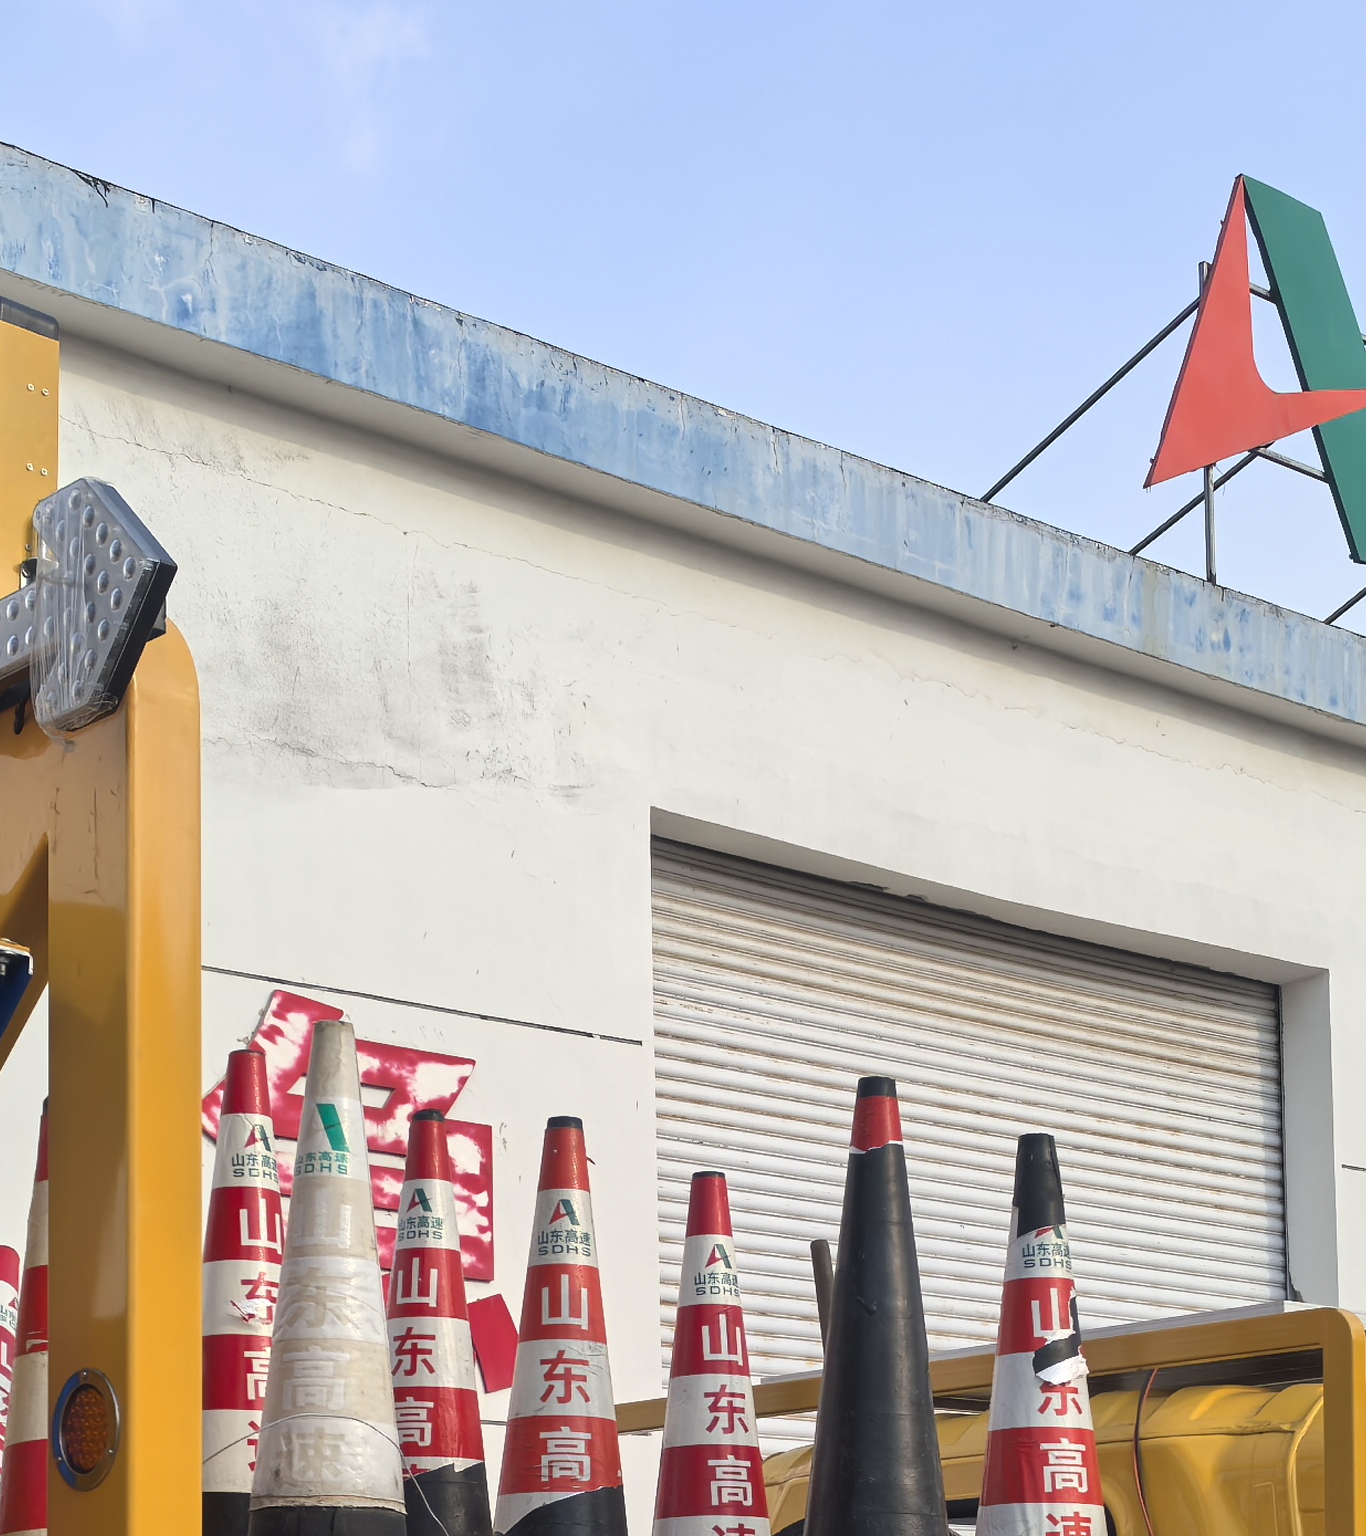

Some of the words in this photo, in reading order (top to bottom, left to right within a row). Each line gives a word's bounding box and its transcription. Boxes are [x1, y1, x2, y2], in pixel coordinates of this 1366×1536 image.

[537, 1230, 591, 1246] 山东高速
[538, 1245, 591, 1257] SDHS
